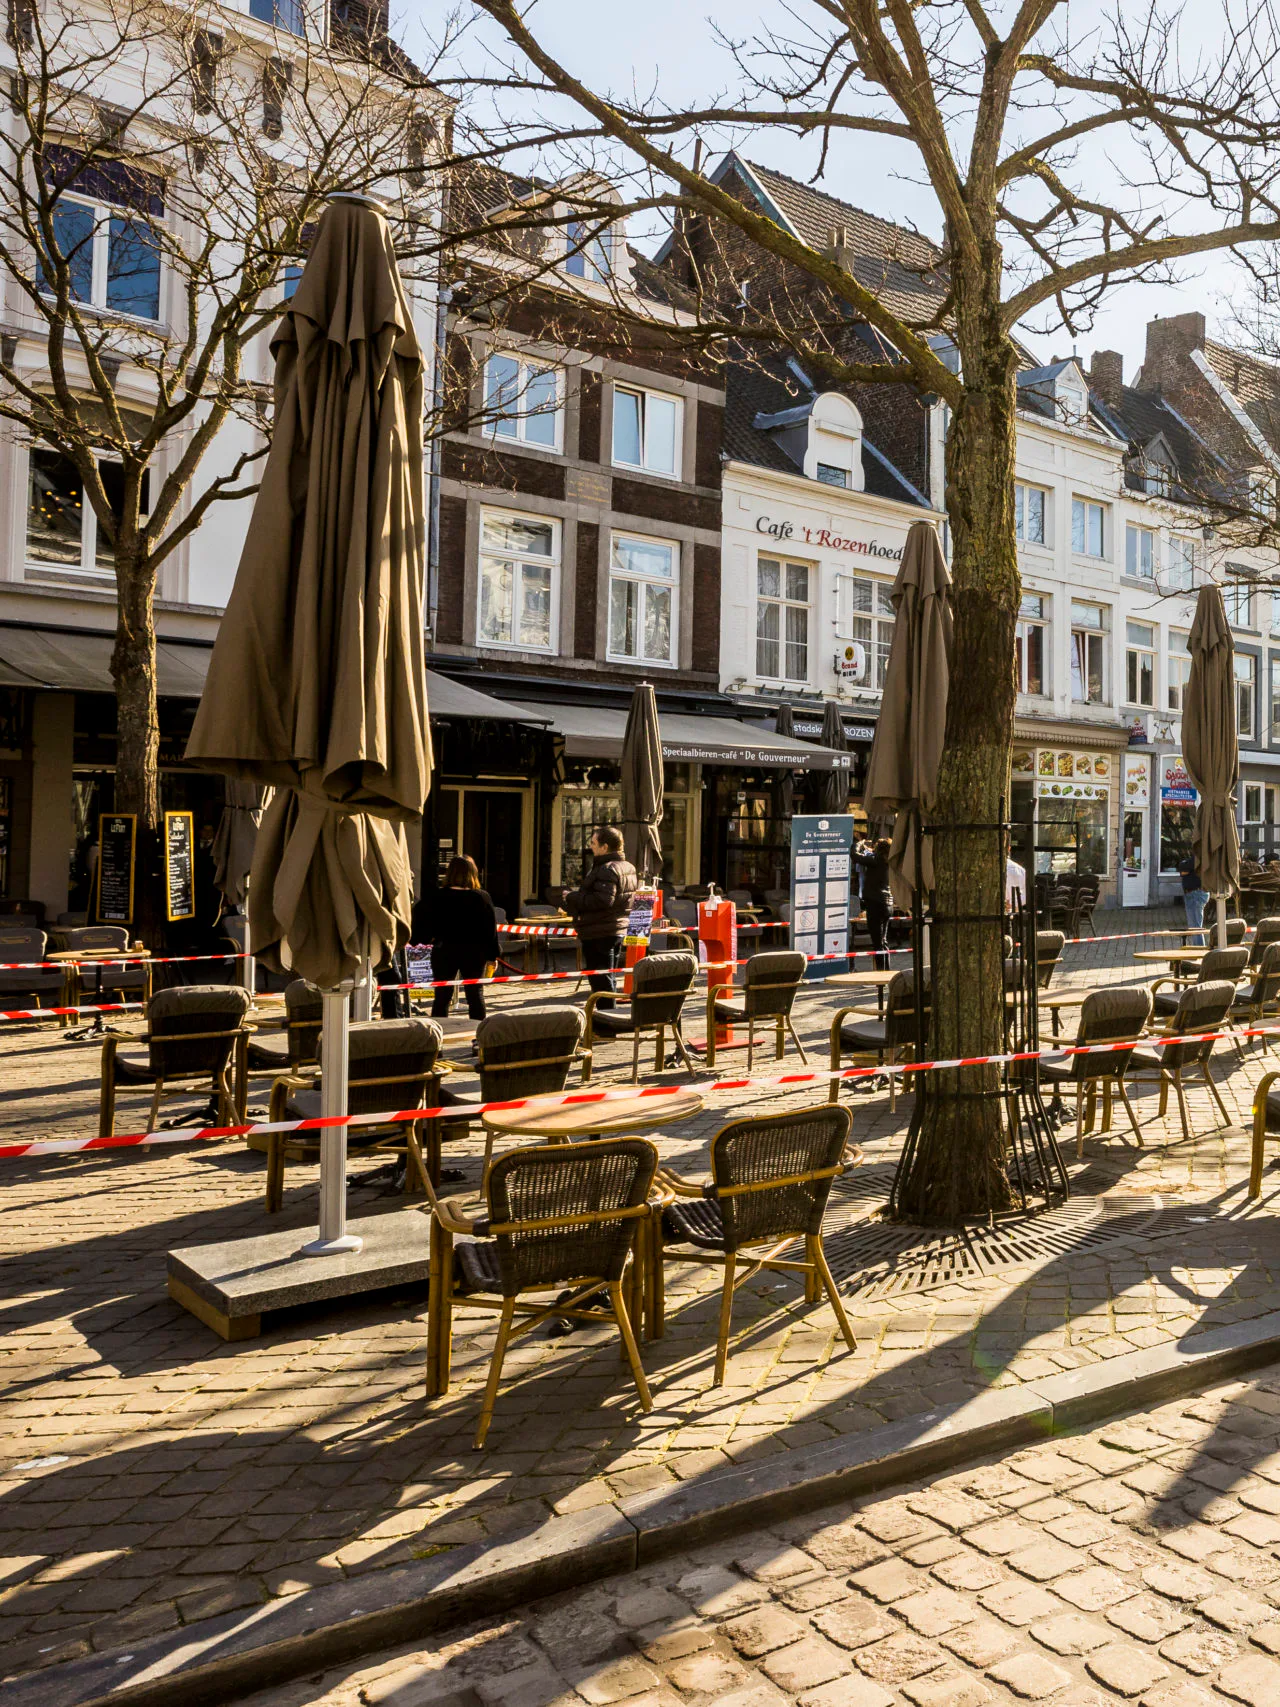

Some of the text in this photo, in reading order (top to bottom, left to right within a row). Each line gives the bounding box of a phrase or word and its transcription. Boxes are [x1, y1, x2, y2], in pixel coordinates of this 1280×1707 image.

[756, 516, 793, 542] Café
[802, 526, 812, 543] 't
[662, 746, 737, 760] Speciaalbieren-café
